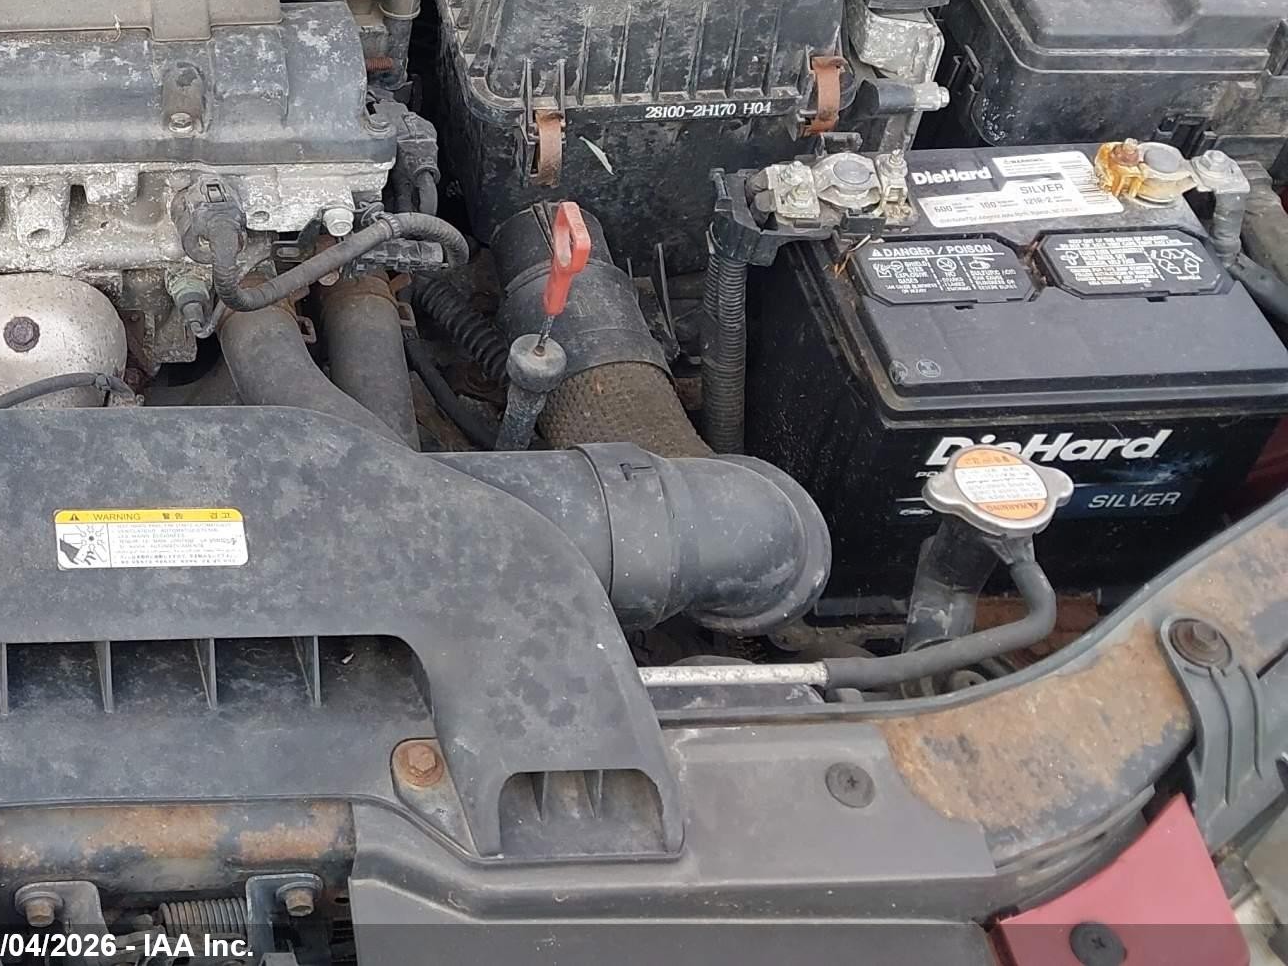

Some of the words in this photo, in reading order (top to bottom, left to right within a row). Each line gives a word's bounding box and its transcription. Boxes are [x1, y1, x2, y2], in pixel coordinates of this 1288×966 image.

[645, 103, 737, 119] 28100-2H170
[743, 101, 772, 114] H04
[911, 166, 993, 185] DieHard
[1020, 183, 1065, 195] SILVER
[980, 201, 997, 209] 100
[882, 247, 935, 257] DANGER
[946, 244, 994, 254] POISON
[925, 429, 1173, 466] DHard
[1087, 492, 1181, 509] SILVER
[93, 512, 141, 521] WARNING
